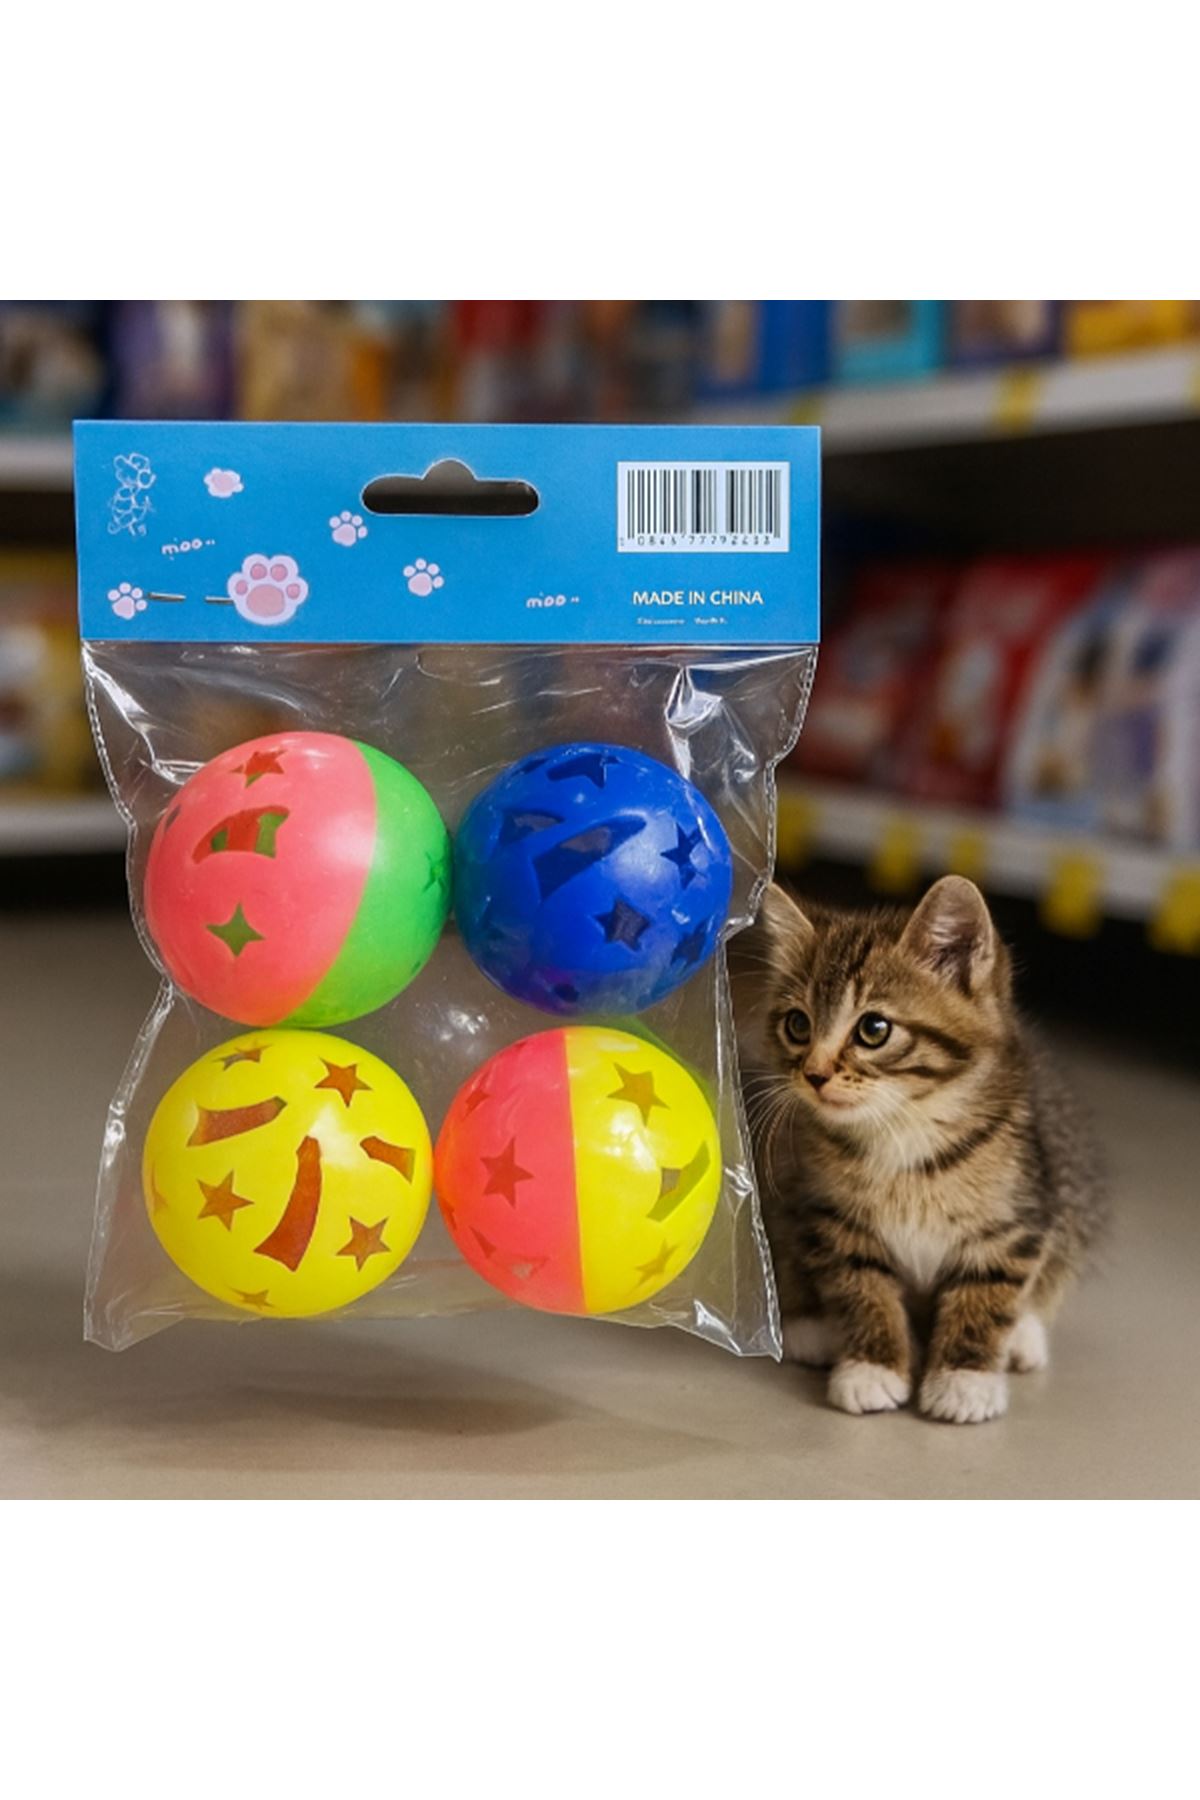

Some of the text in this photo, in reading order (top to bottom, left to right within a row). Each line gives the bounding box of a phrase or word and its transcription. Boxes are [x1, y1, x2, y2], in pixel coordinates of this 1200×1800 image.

[632, 590, 764, 606] MADE IN CHINA
